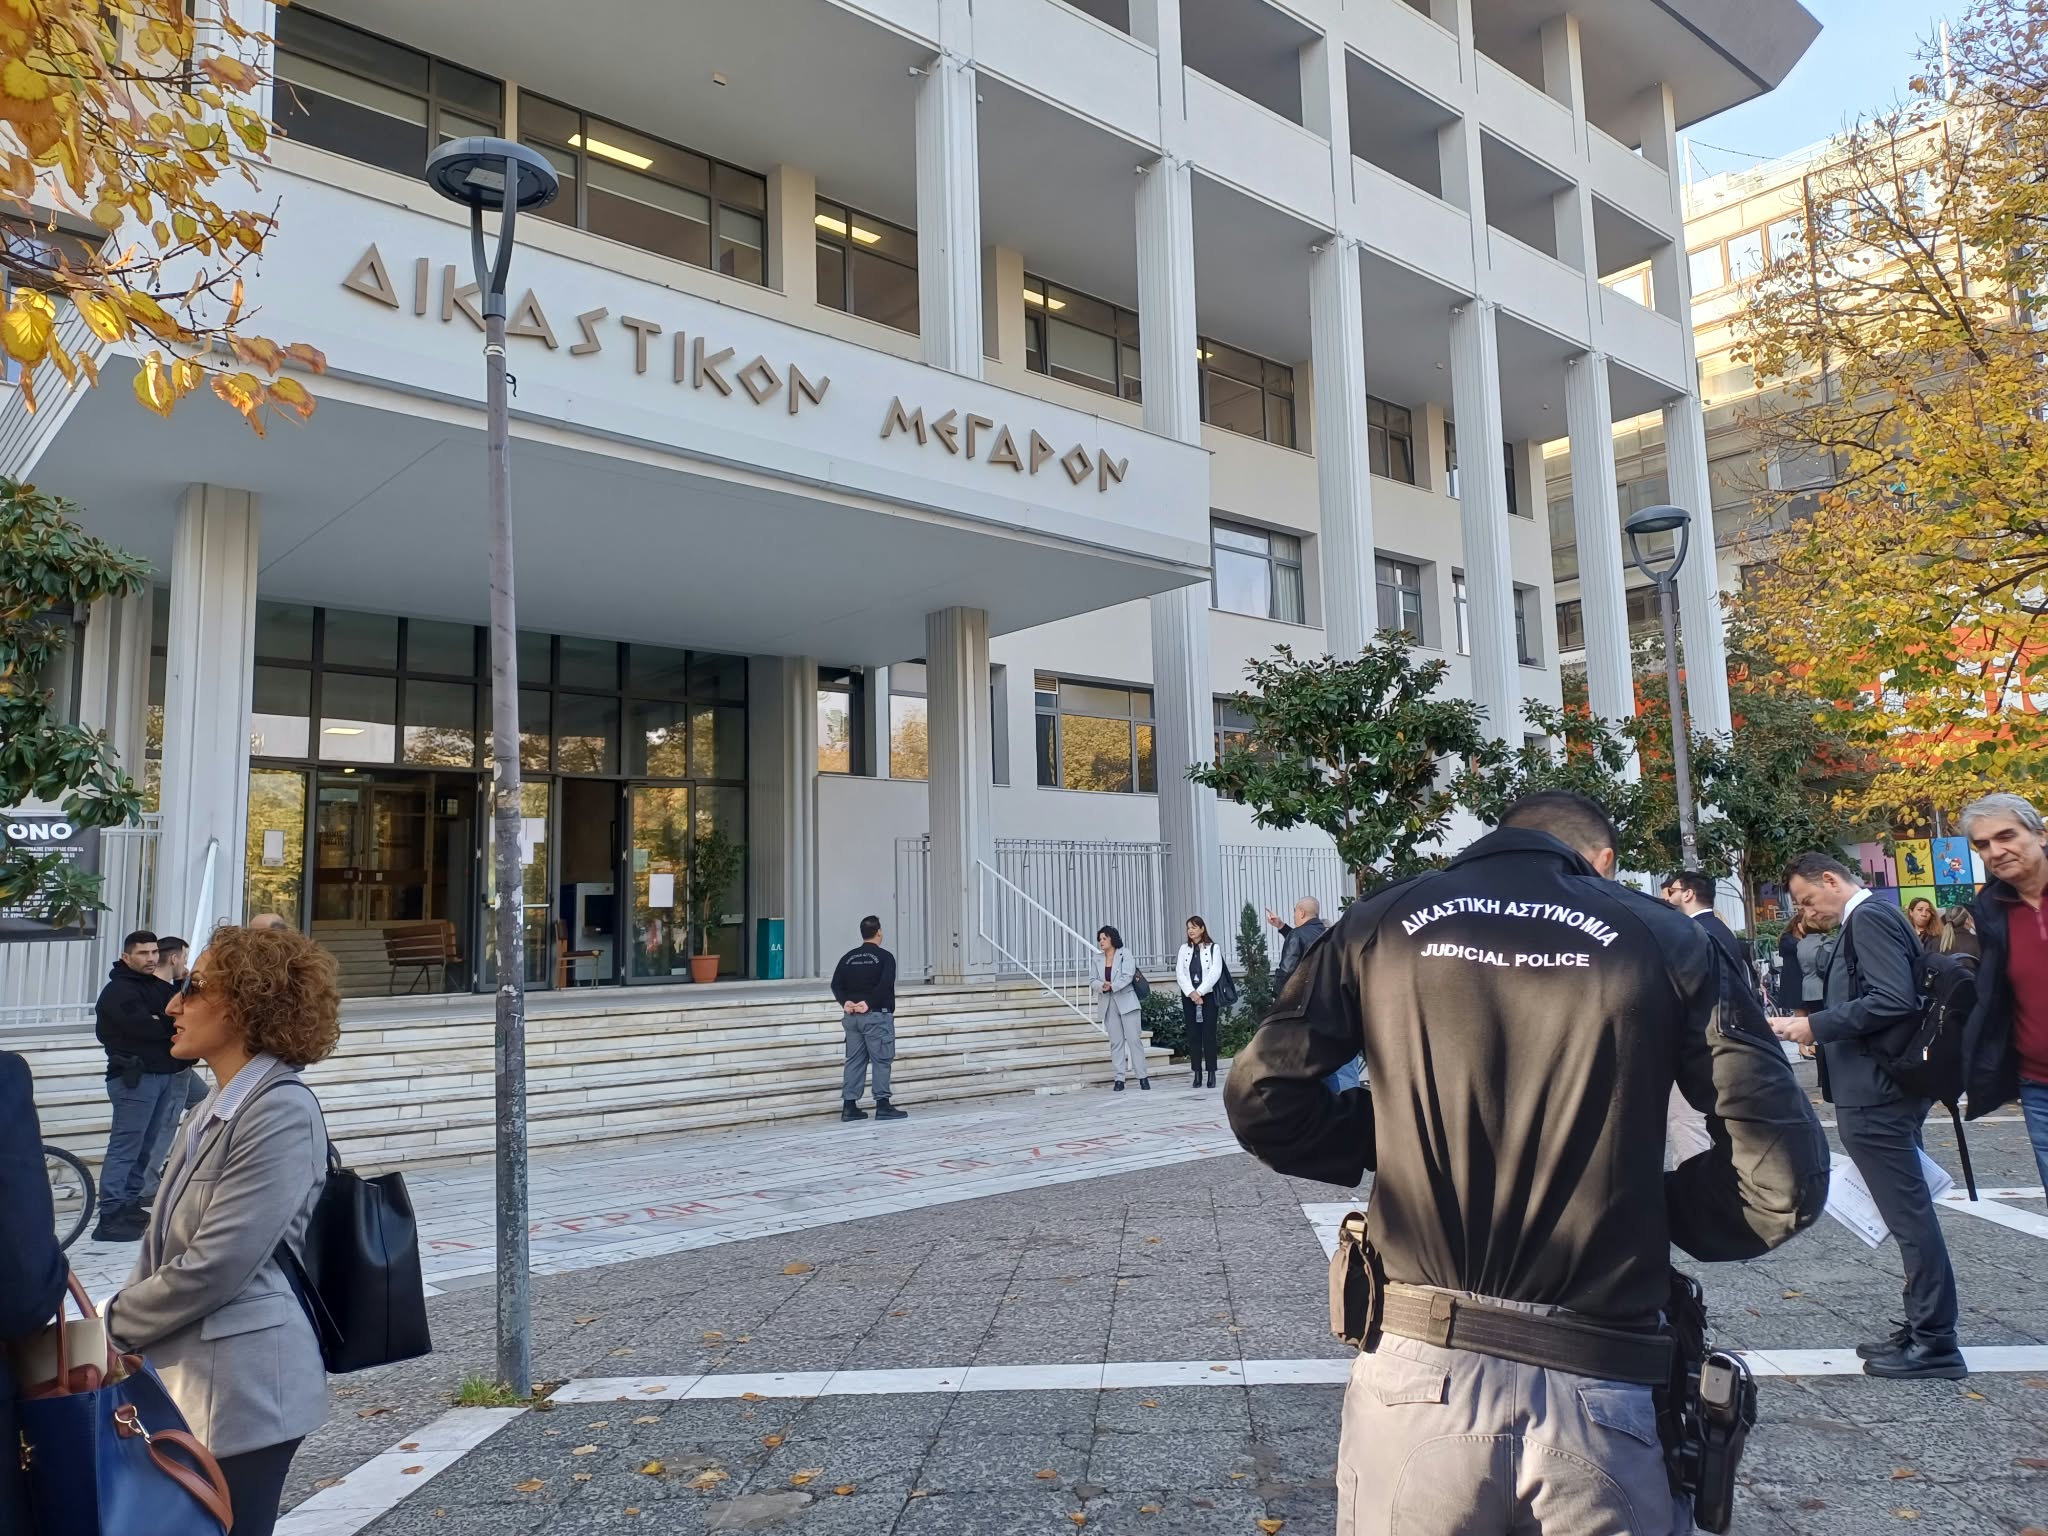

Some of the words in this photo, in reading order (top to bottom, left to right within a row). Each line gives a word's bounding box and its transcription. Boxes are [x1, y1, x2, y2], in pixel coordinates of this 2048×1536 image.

[342, 242, 831, 415] ΔΙΚΑΣΤΙΚΟΝ
[880, 395, 1129, 492] ΜΕΓΑΡΟΝ
[1401, 897, 1500, 936] ΔΙΚΑΣΤΙΚΗ
[1504, 901, 1618, 947] ΑΣΤΥΝΟΜΙΑ
[1421, 943, 1509, 967] JUDICIAL
[1515, 953, 1590, 967] POLICE
